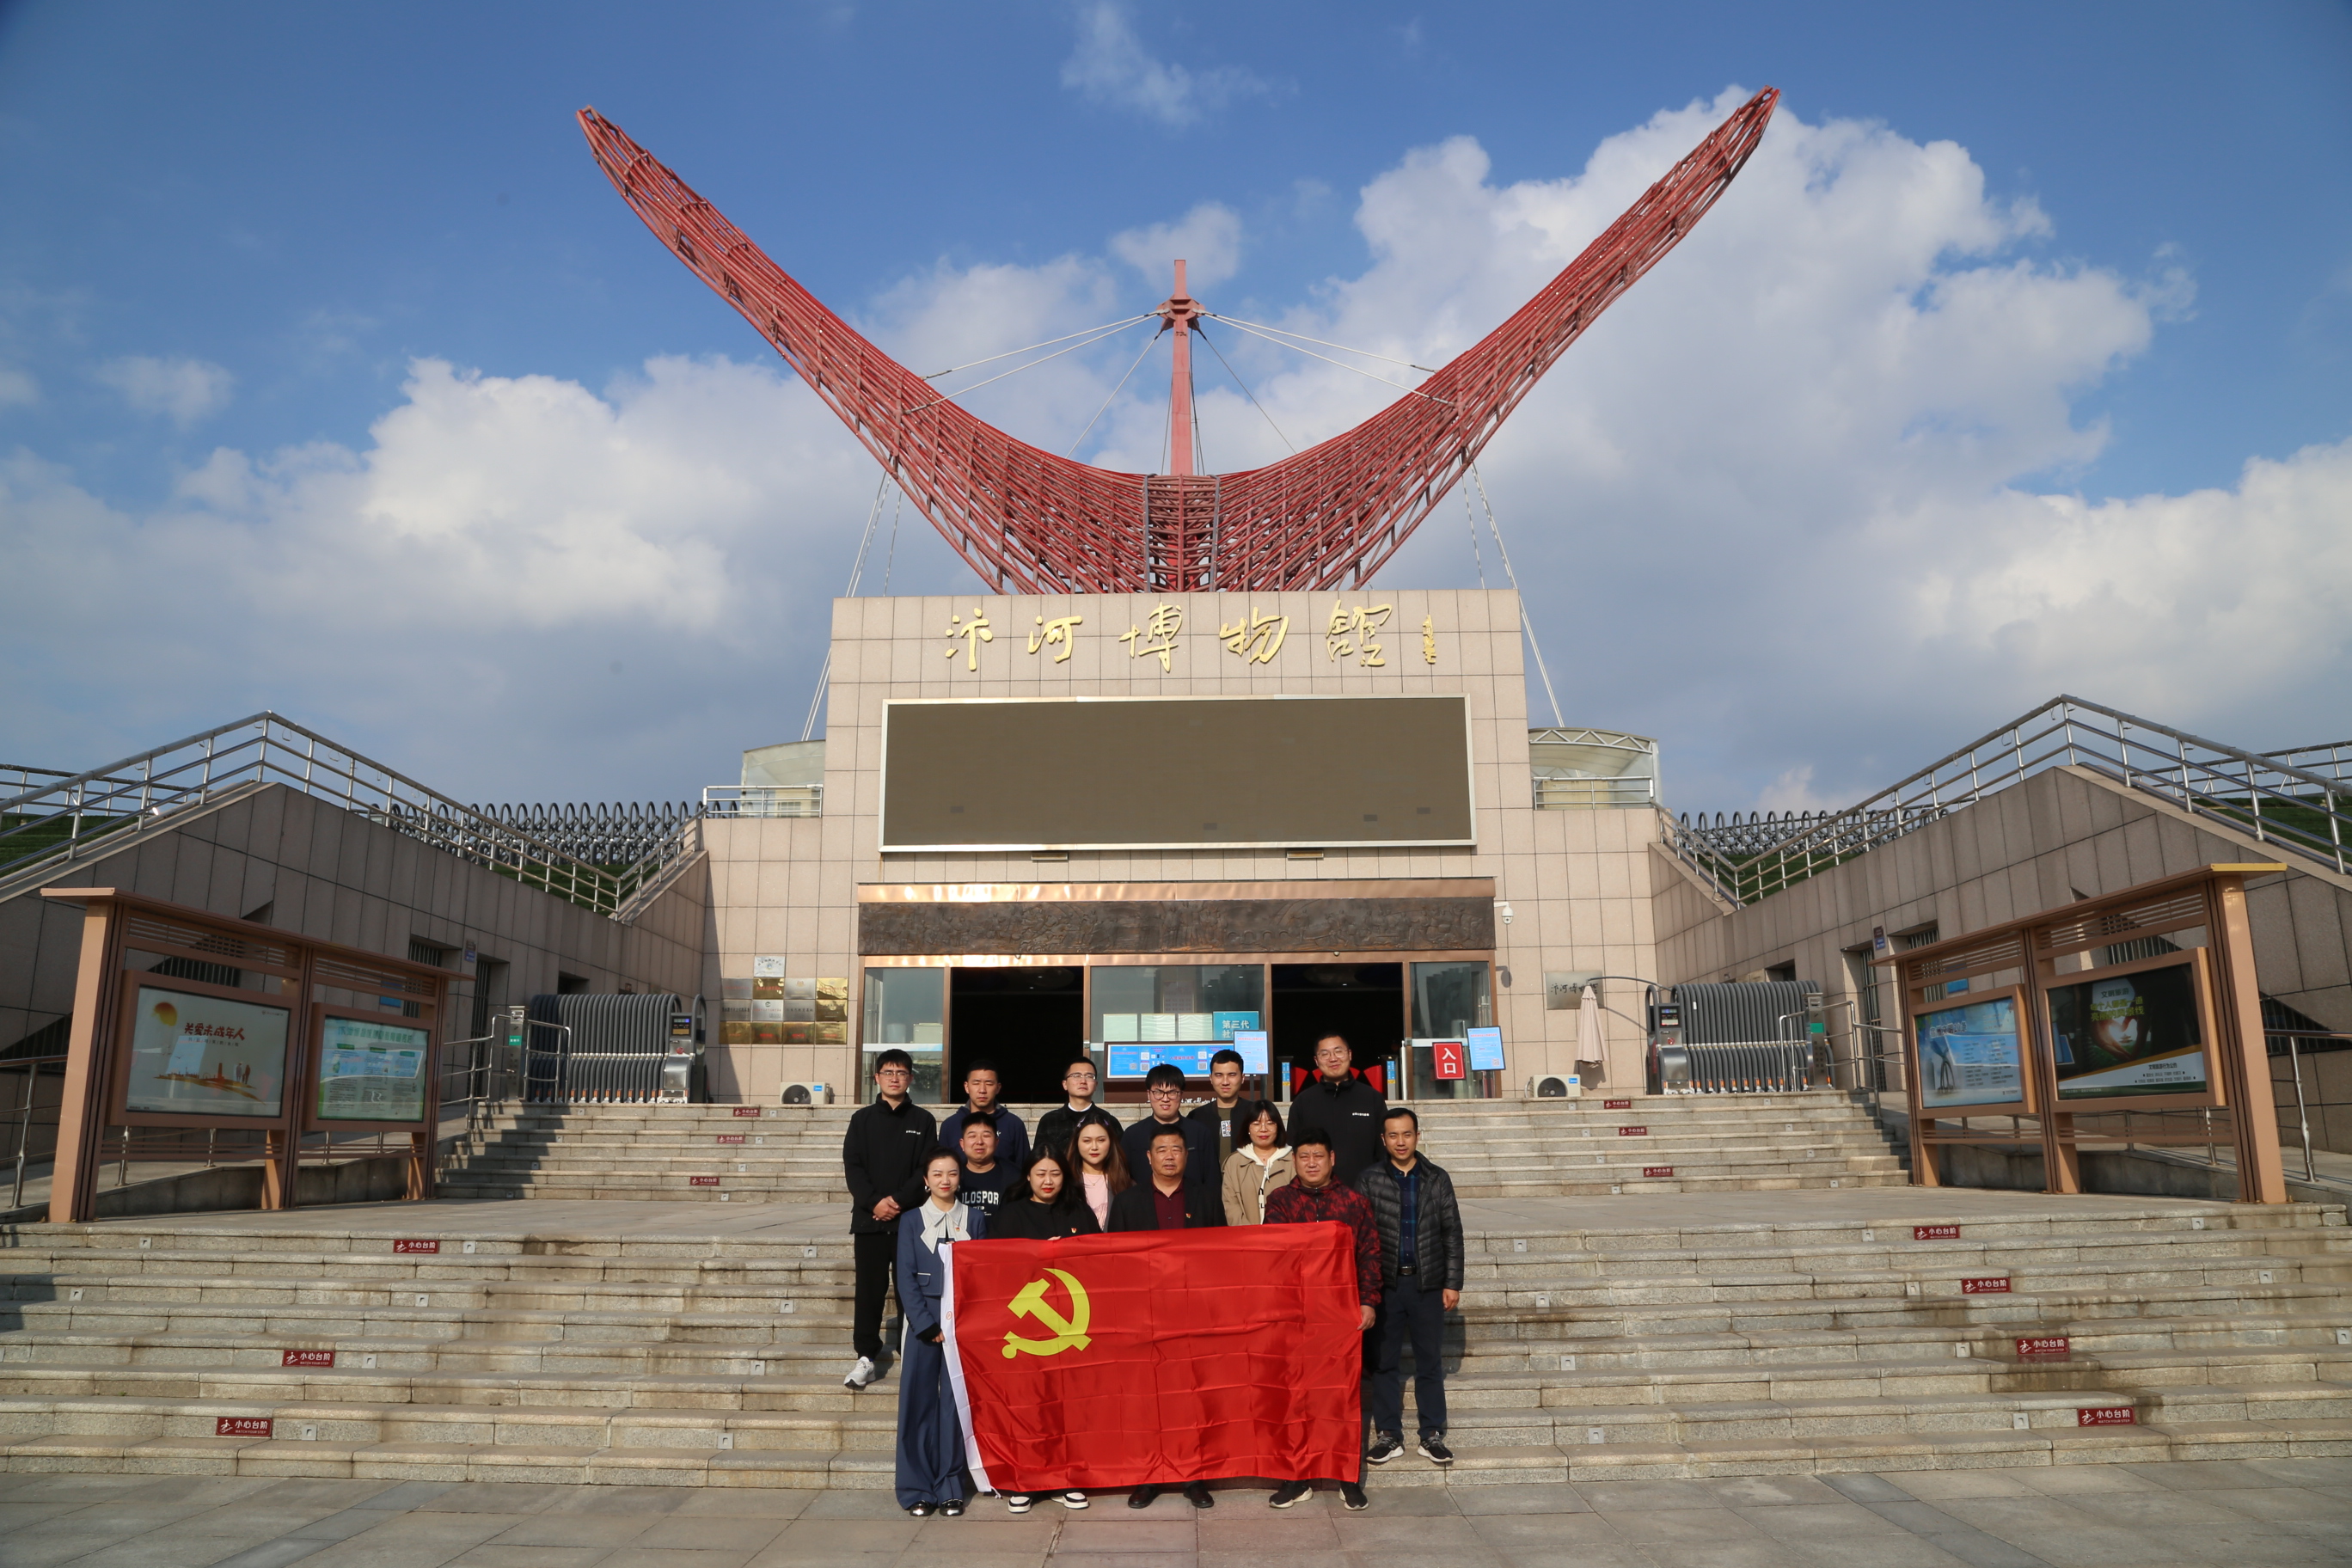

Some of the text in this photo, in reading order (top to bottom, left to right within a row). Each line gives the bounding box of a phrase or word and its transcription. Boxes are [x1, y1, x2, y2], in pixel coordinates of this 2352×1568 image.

[1222, 1020, 1250, 1029] 第三代
[184, 1023, 246, 1041] 关爱未成年人
[1442, 1047, 1457, 1075] 入口
[962, 1191, 999, 1205] LOSPOR
[1928, 1227, 1957, 1235] 小心台阶
[1977, 1279, 2006, 1288] 小心台阶
[2033, 1338, 2064, 1348] 小心台阶
[300, 1352, 331, 1361] 小心台阶
[2096, 1409, 2130, 1418] 小心台阶
[235, 1419, 268, 1430] 小心台阶
